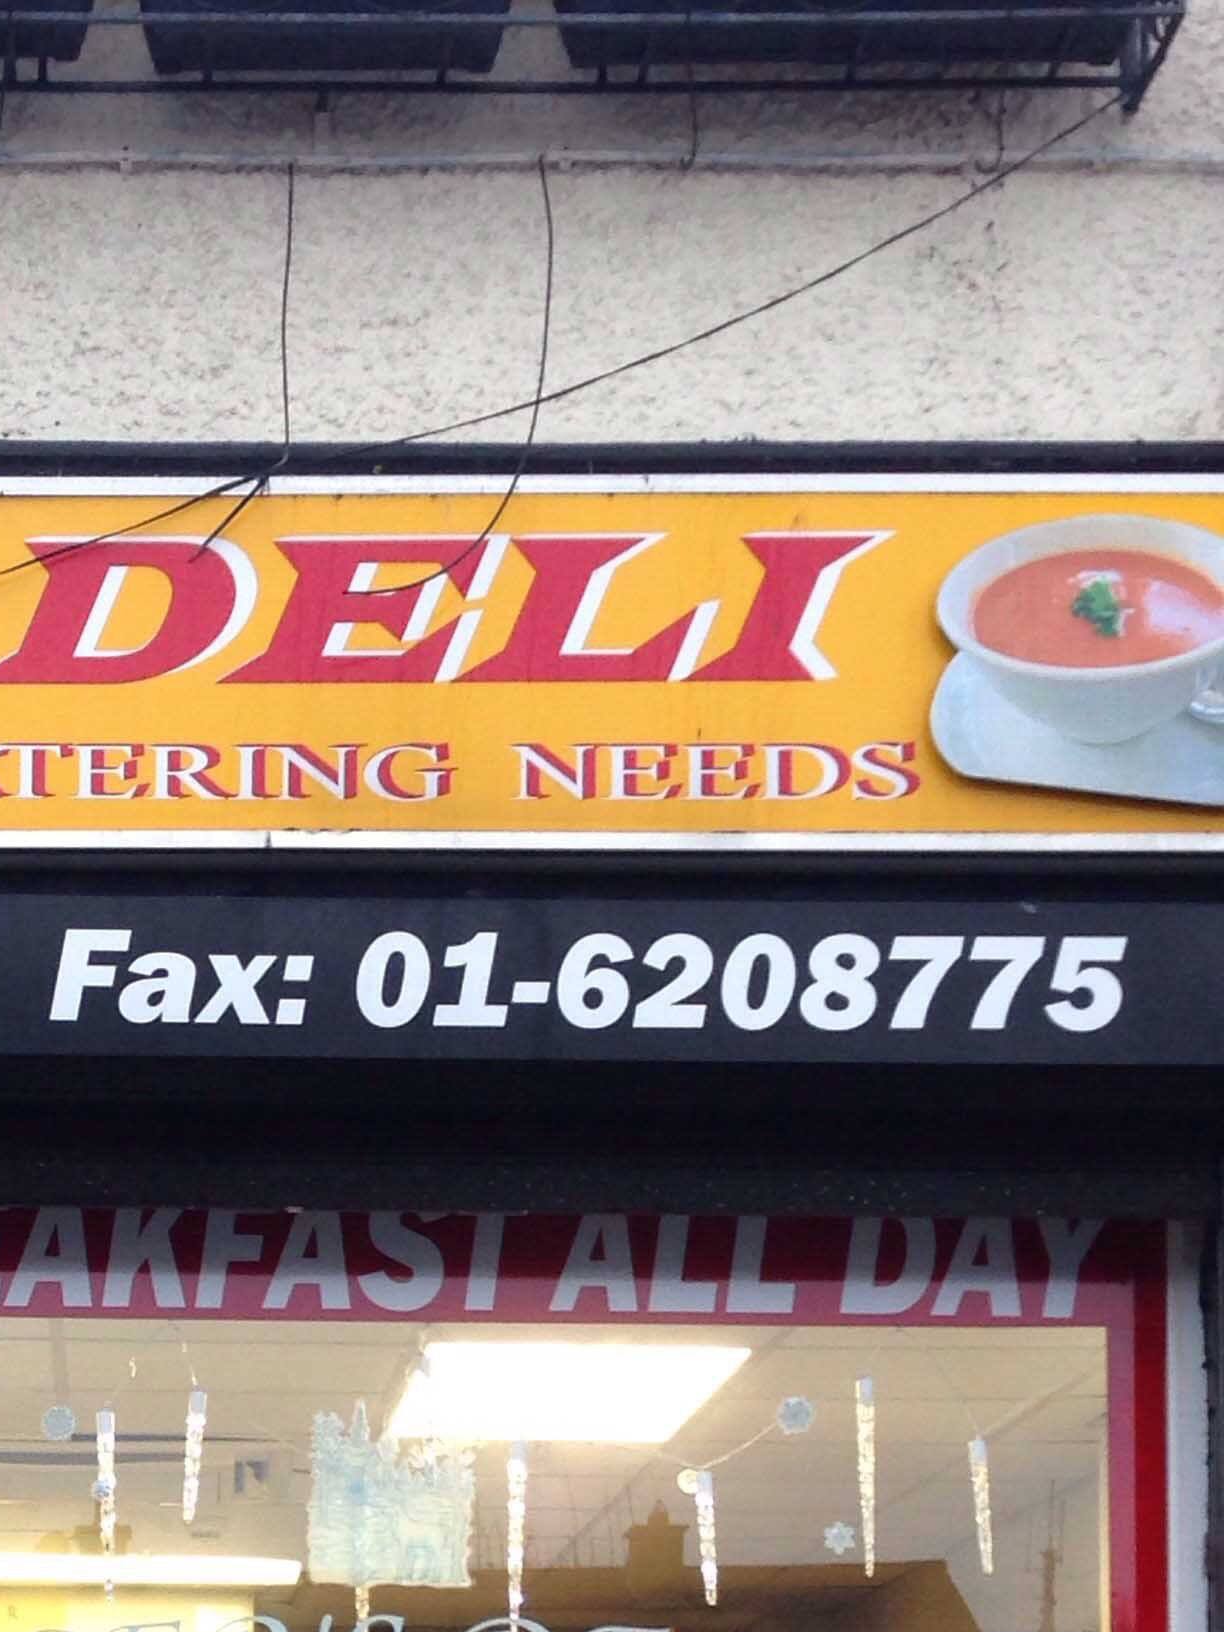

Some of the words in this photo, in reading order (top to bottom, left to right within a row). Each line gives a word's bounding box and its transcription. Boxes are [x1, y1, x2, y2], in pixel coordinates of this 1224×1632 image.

[511, 742, 923, 800] NEEDS
[49, 928, 313, 1027] Fax:
[355, 930, 1131, 1033] 01-6208775
[548, 1214, 795, 1314] ALL
[839, 1216, 1109, 1319] DAY
